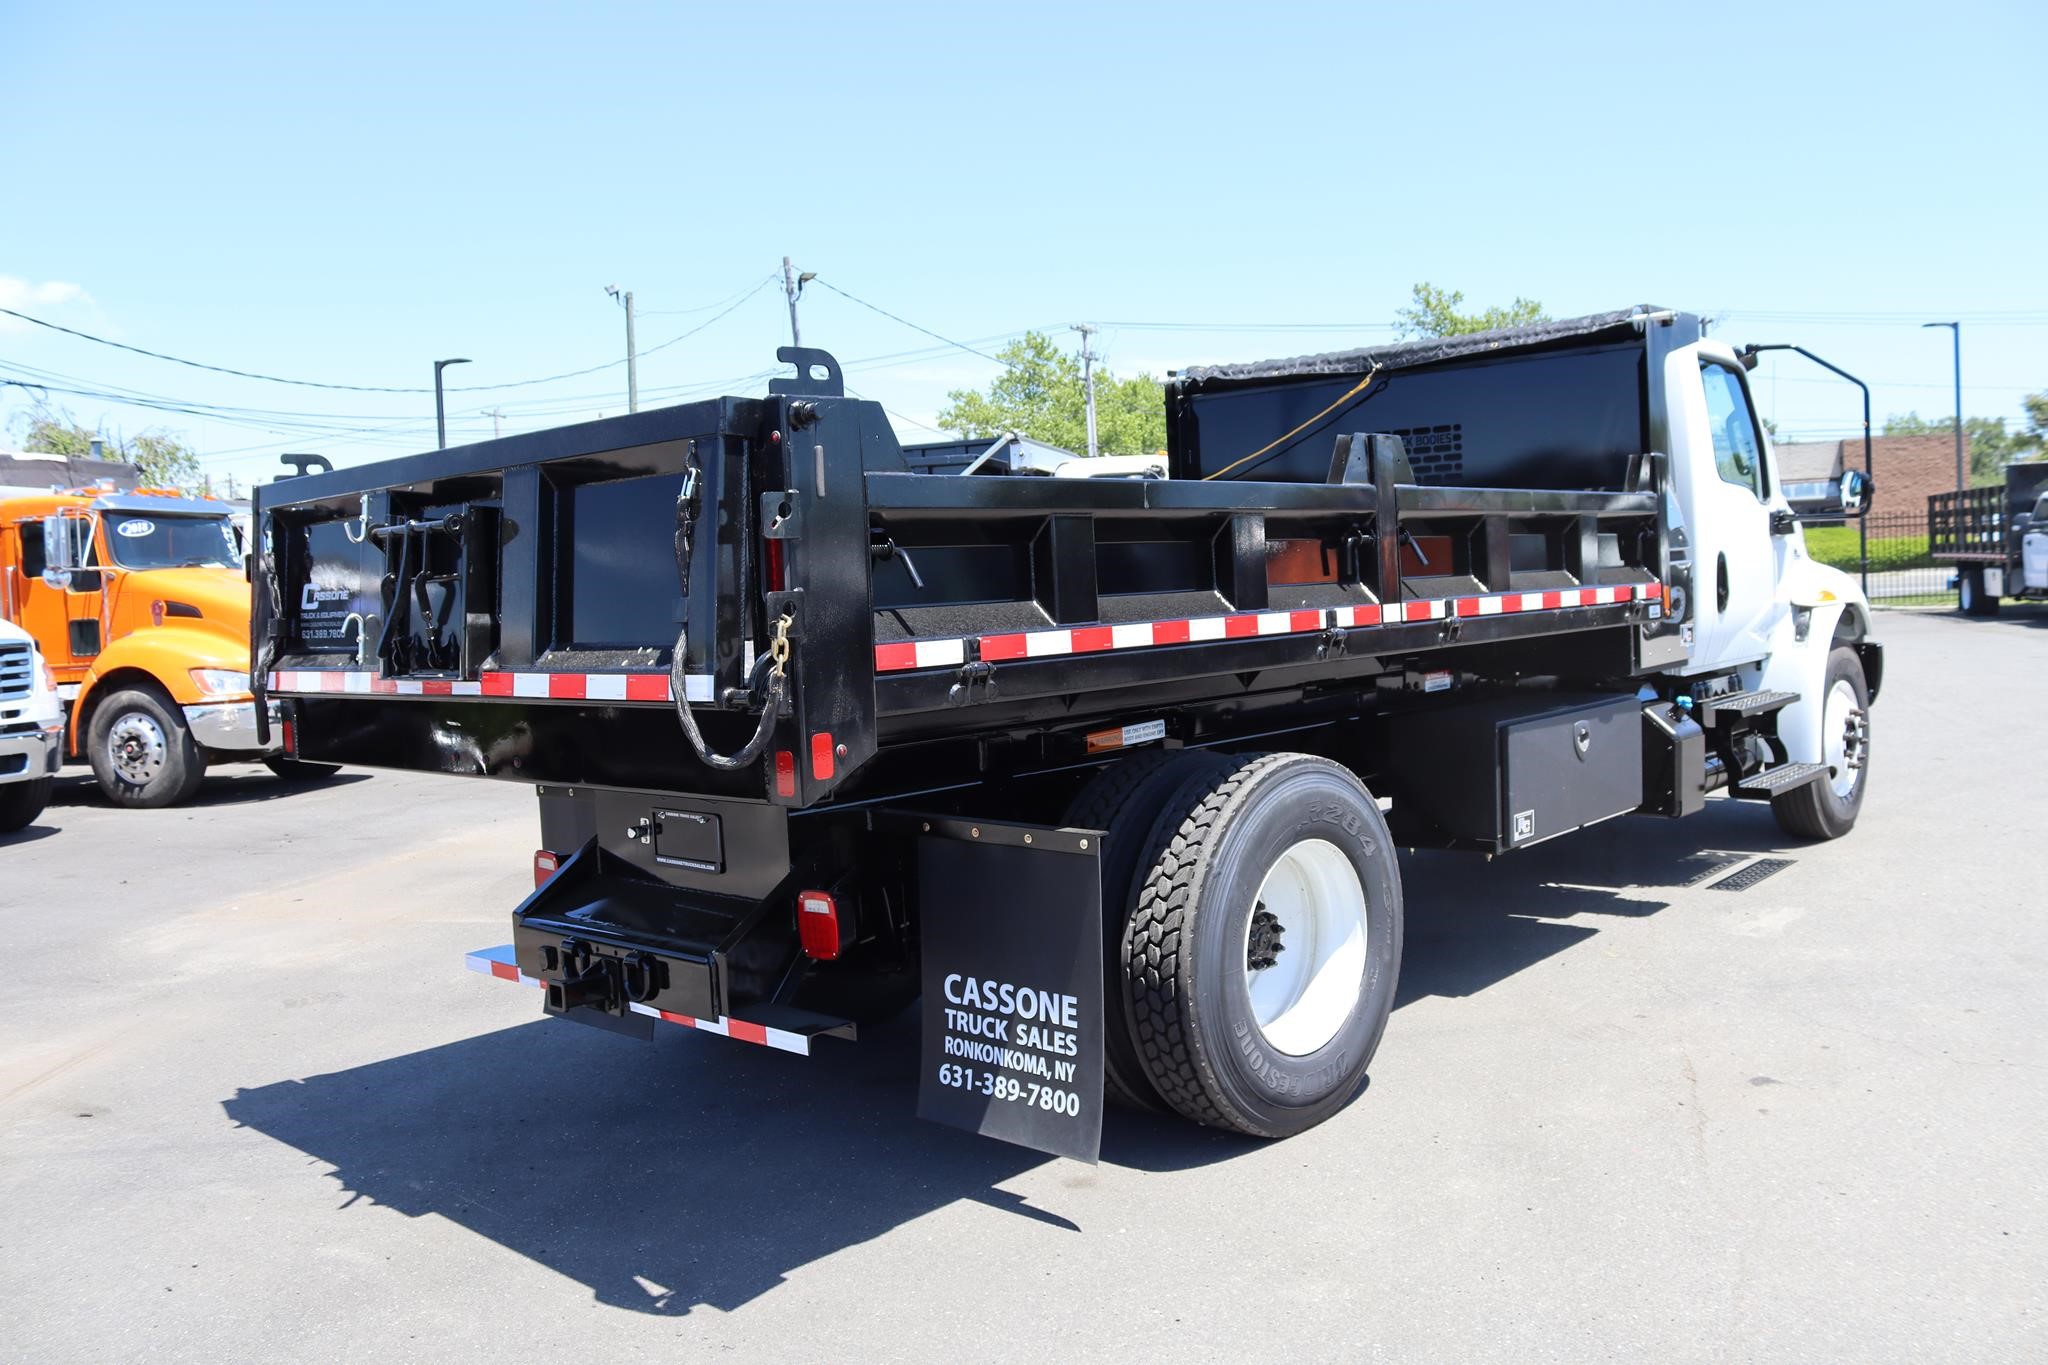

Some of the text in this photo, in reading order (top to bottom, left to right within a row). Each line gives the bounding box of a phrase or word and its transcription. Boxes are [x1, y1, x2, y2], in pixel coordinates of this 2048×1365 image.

[1415, 433, 1452, 446] BODIES
[301, 583, 349, 610] CASSONE
[944, 973, 1078, 1028] CASSONE
[944, 1008, 1077, 1056] TRUCK SALES
[944, 1035, 1076, 1083] RONKONKOMA, NY
[939, 1063, 1080, 1117] 631-389-7800
